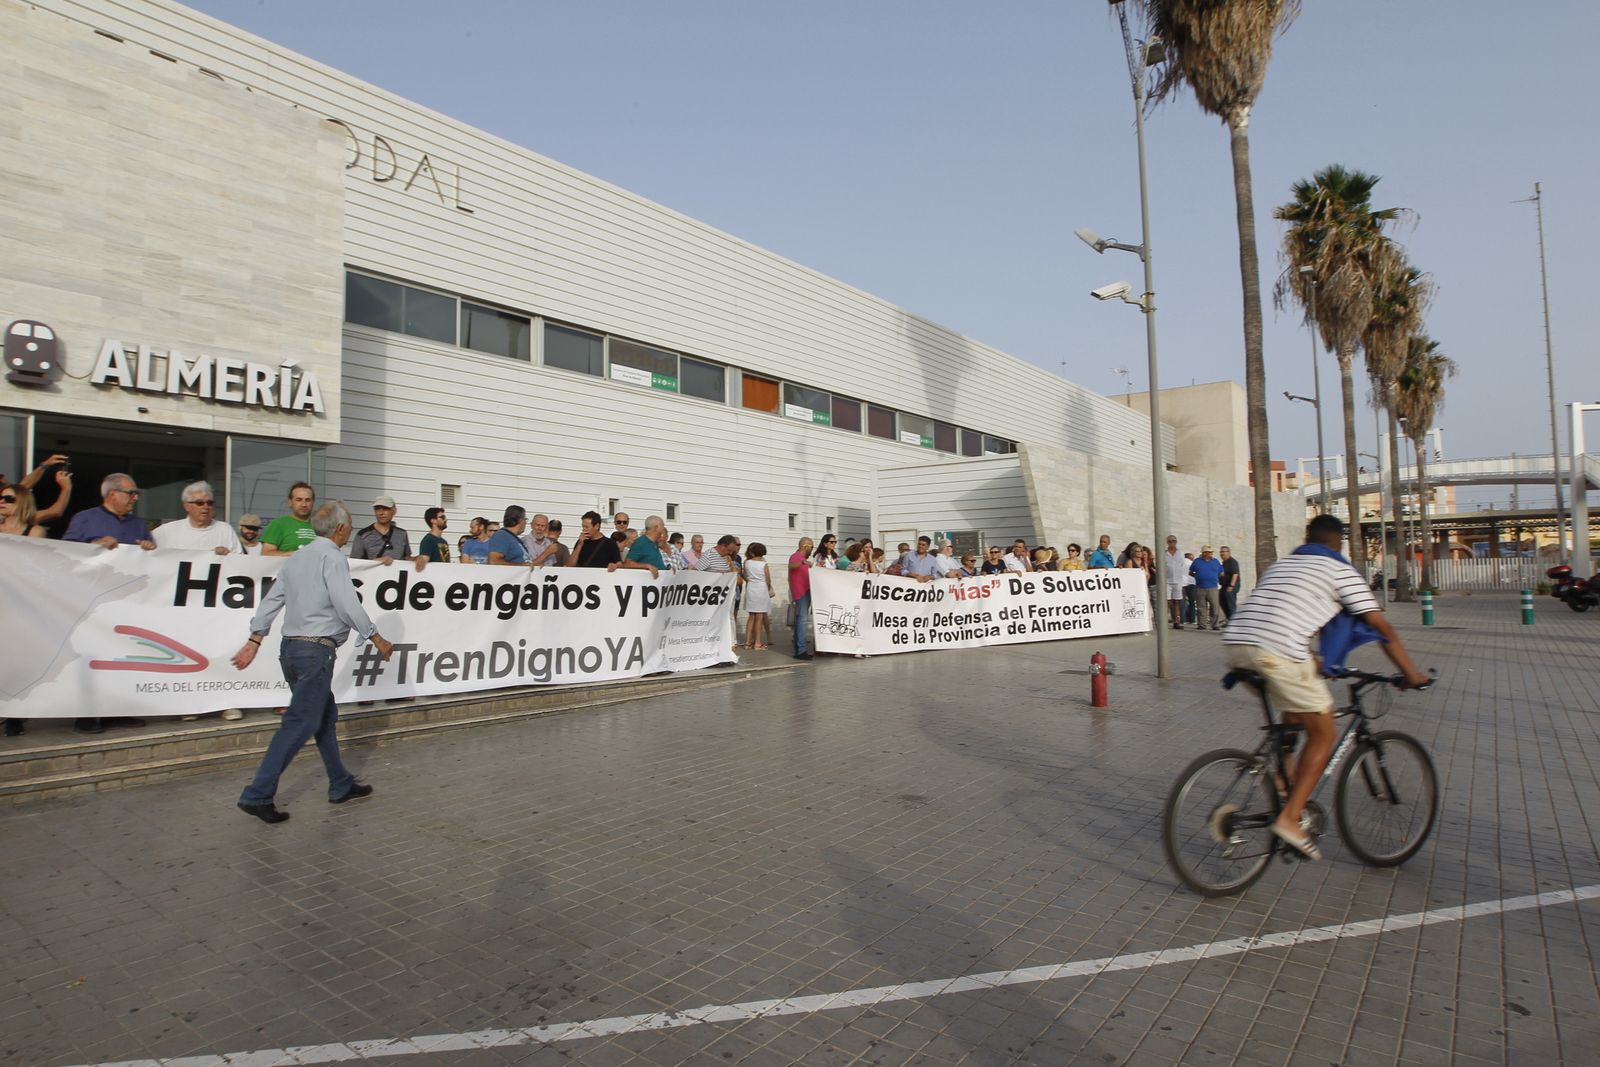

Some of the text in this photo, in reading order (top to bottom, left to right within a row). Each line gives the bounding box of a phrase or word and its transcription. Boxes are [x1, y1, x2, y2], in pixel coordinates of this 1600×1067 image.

[90, 338, 326, 413] ALMERÍA
[375, 570, 435, 611] de
[445, 574, 600, 620] engaños
[614, 585, 633, 617] y
[642, 583, 729, 617] promesas
[861, 580, 944, 602] Buscando
[1009, 578, 1035, 595] De
[1043, 573, 1121, 593] Solución
[872, 600, 1110, 628] Mesa en Defensa del Ferrocarril
[892, 616, 1091, 644] de la Provincia de Almería
[353, 637, 644, 687] #TrenDignoYA
[135, 683, 169, 693] MESA
[173, 682, 193, 692] DEL
[196, 681, 270, 691] FERROCARRIL
